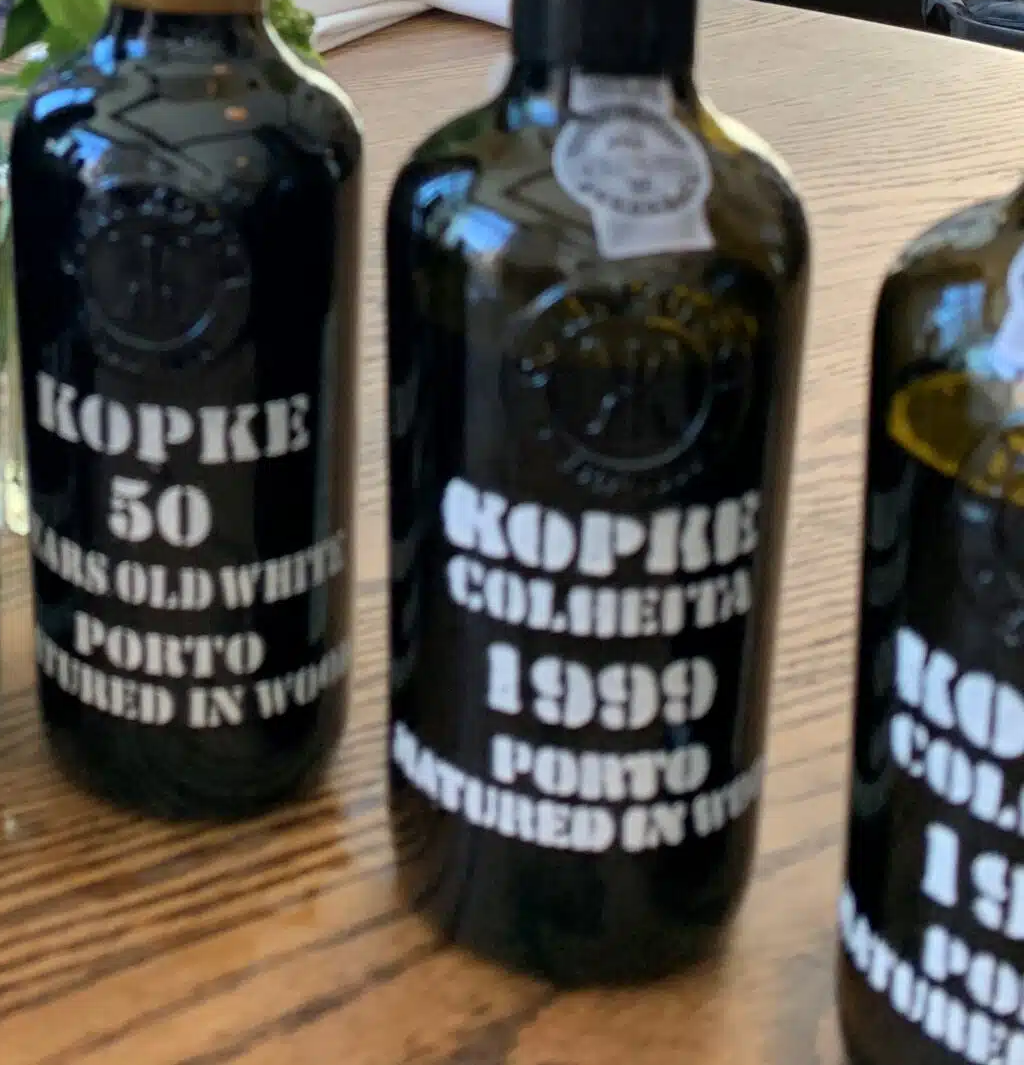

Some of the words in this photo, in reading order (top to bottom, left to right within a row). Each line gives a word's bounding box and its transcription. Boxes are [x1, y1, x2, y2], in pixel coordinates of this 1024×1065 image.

[36, 370, 311, 464] KOPKE
[107, 476, 212, 548] 50
[441, 477, 761, 576] KOPKE
[115, 559, 215, 612] OLD
[447, 554, 753, 638] COLHEITA
[75, 609, 266, 679] PORTO
[187, 684, 246, 729] IN
[485, 641, 717, 730] 1999
[491, 734, 711, 802] PORTO
[620, 802, 688, 852] IN
